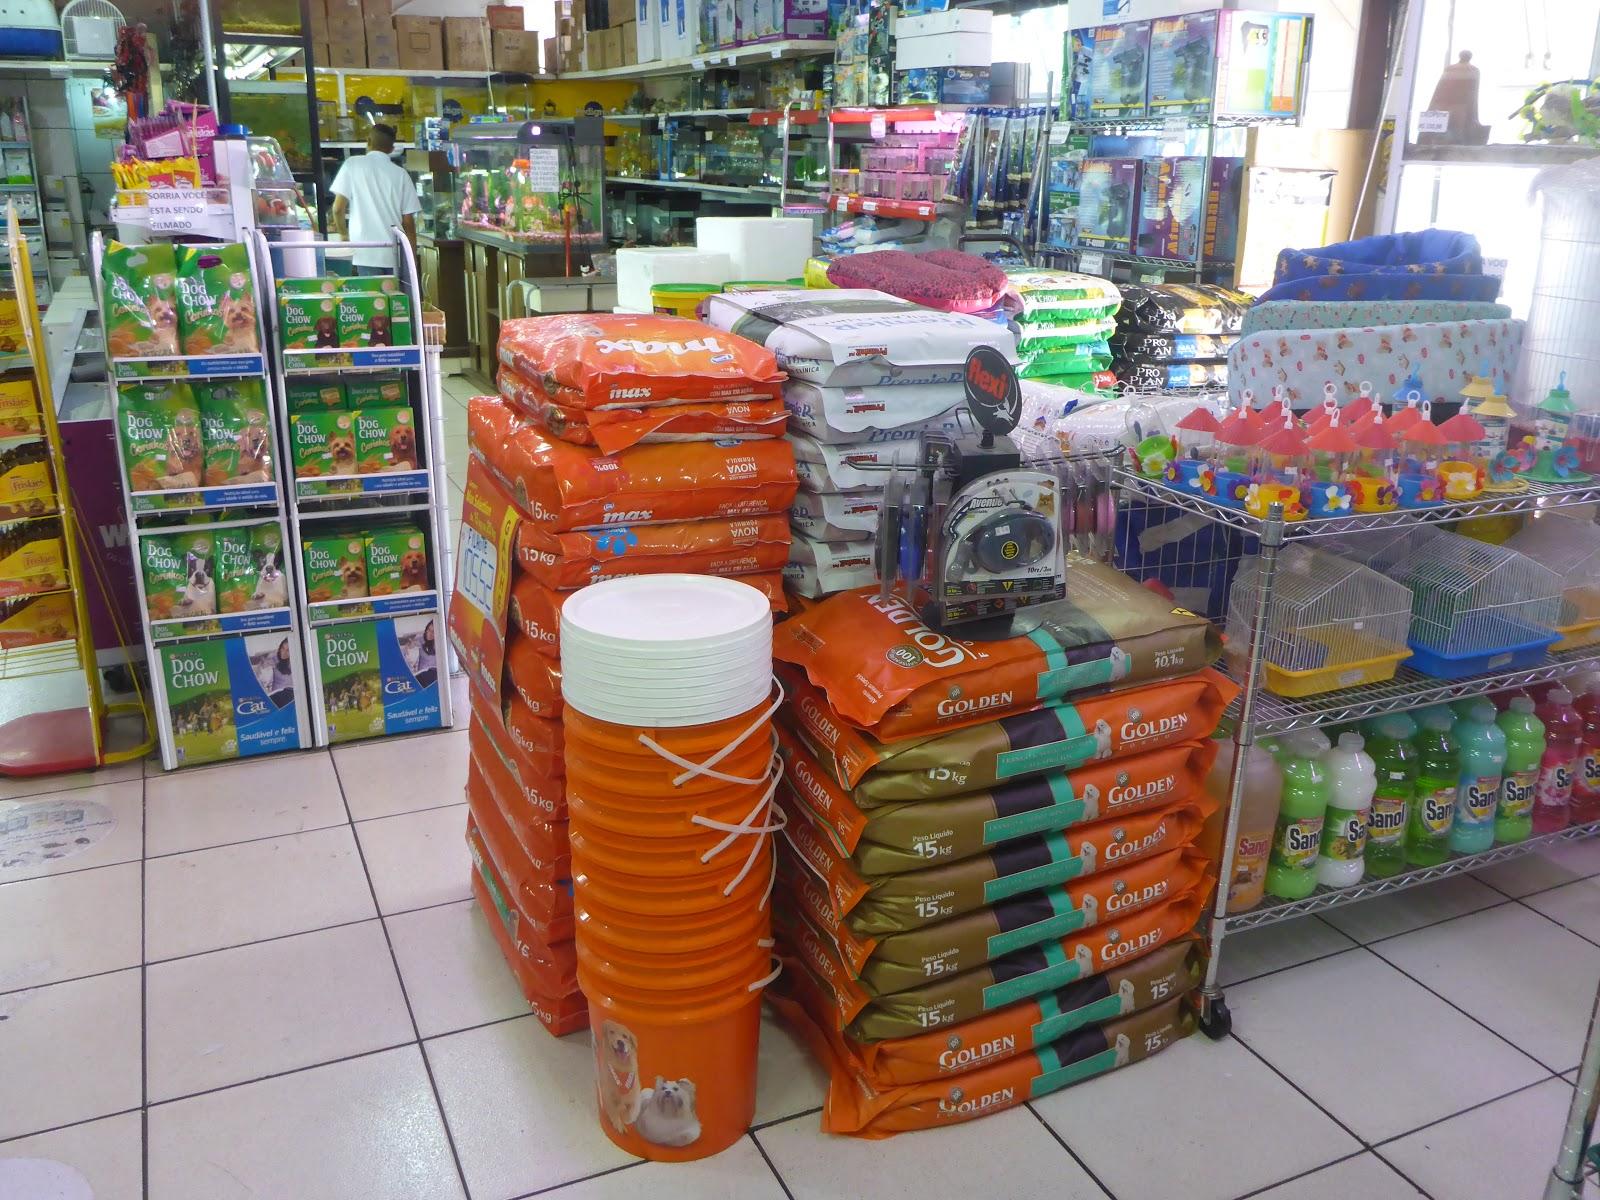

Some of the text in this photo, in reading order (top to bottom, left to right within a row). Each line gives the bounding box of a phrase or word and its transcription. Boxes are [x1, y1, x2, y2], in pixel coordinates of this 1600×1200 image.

[148, 191, 181, 200] SORRIA
[152, 221, 192, 229] FILMADO
[181, 282, 206, 294] DOG
[182, 293, 217, 306] CHOW
[287, 306, 304, 315] DOG
[340, 305, 358, 314] DOG
[286, 315, 311, 324] CHOW
[340, 314, 364, 322] CHOW
[595, 337, 725, 355] max
[1143, 338, 1168, 348] PRO
[1138, 346, 1172, 356] PLAN
[967, 356, 1010, 400] flexi
[1136, 367, 1161, 378] PRO
[1130, 375, 1164, 386] PLAN
[609, 386, 651, 399] max
[726, 405, 750, 415] NOVA
[128, 415, 153, 428] DOG
[359, 419, 379, 430] DOG
[127, 428, 164, 441] CHOW
[297, 425, 318, 434] DOG
[359, 429, 387, 439] CHOW
[296, 434, 326, 444] CHOW
[594, 463, 619, 472] 100%
[727, 463, 757, 474] NOVA
[969, 497, 1003, 509] Avenue
[603, 509, 653, 523] max
[731, 526, 759, 538] NOVA
[148, 544, 172, 557] DOG
[223, 541, 247, 554] DOG
[370, 546, 391, 556] DOG
[309, 550, 330, 560] DOG
[370, 555, 398, 565] CHOW
[146, 556, 181, 569] CHOW
[309, 559, 337, 569] CHOW
[525, 619, 556, 643] 15kg
[327, 638, 357, 654] DOG
[326, 651, 369, 668] CHOW
[895, 648, 917, 662] 100
[172, 658, 205, 674] DOG
[1154, 655, 1184, 669] 10,1kg
[172, 671, 219, 689] CHOW
[385, 680, 412, 694] Cat
[236, 701, 267, 715] Cat
[937, 690, 1014, 717] GOLDEN
[387, 708, 418, 720] Saudável
[425, 705, 438, 713] feliz
[801, 696, 840, 745] GOLDEN
[1120, 711, 1188, 740] GOLDEN
[240, 728, 273, 742] Saudável
[281, 727, 295, 735] feliz
[795, 760, 833, 810] GOLDEN
[1108, 774, 1175, 805] GOLDEN
[1368, 810, 1405, 830] Sanol
[912, 834, 929, 842] Peso
[1105, 821, 1166, 860] GOLDEN
[921, 954, 937, 962] Peso
[939, 1034, 1015, 1069] GOLDEN
